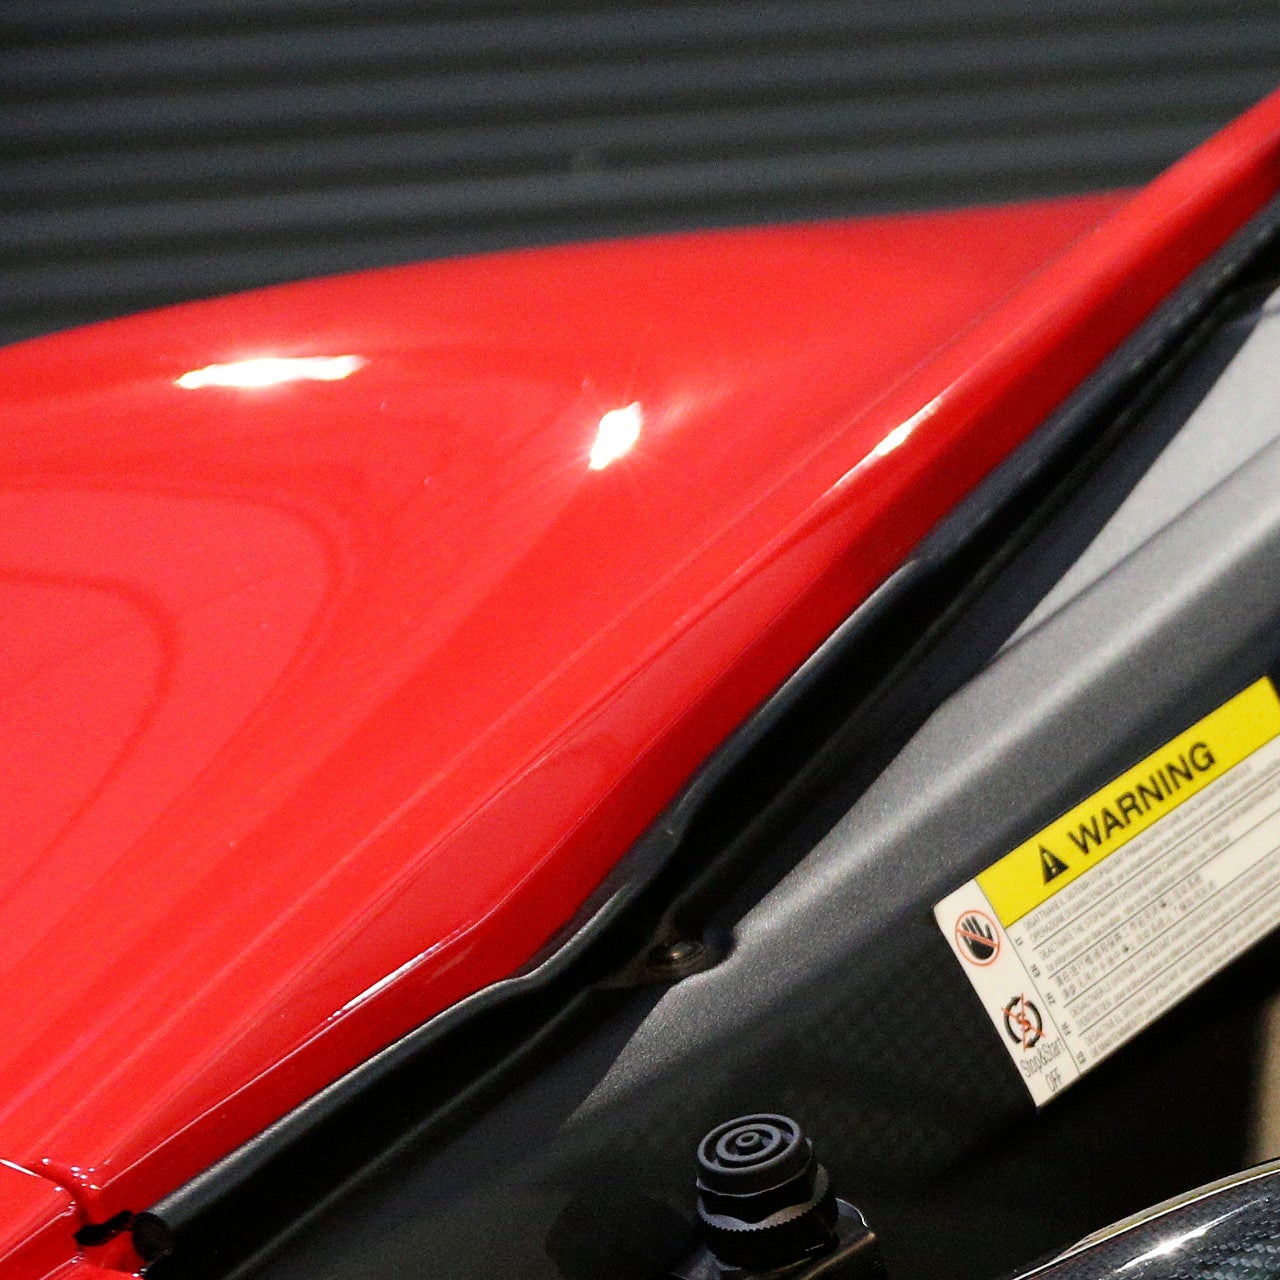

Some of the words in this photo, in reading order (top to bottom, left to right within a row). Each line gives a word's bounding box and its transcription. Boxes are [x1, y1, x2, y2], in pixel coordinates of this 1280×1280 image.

[1066, 741, 1217, 856] WARNING
[1019, 1036, 1065, 1079] Stop&Start
[1045, 1067, 1063, 1094] OFF
